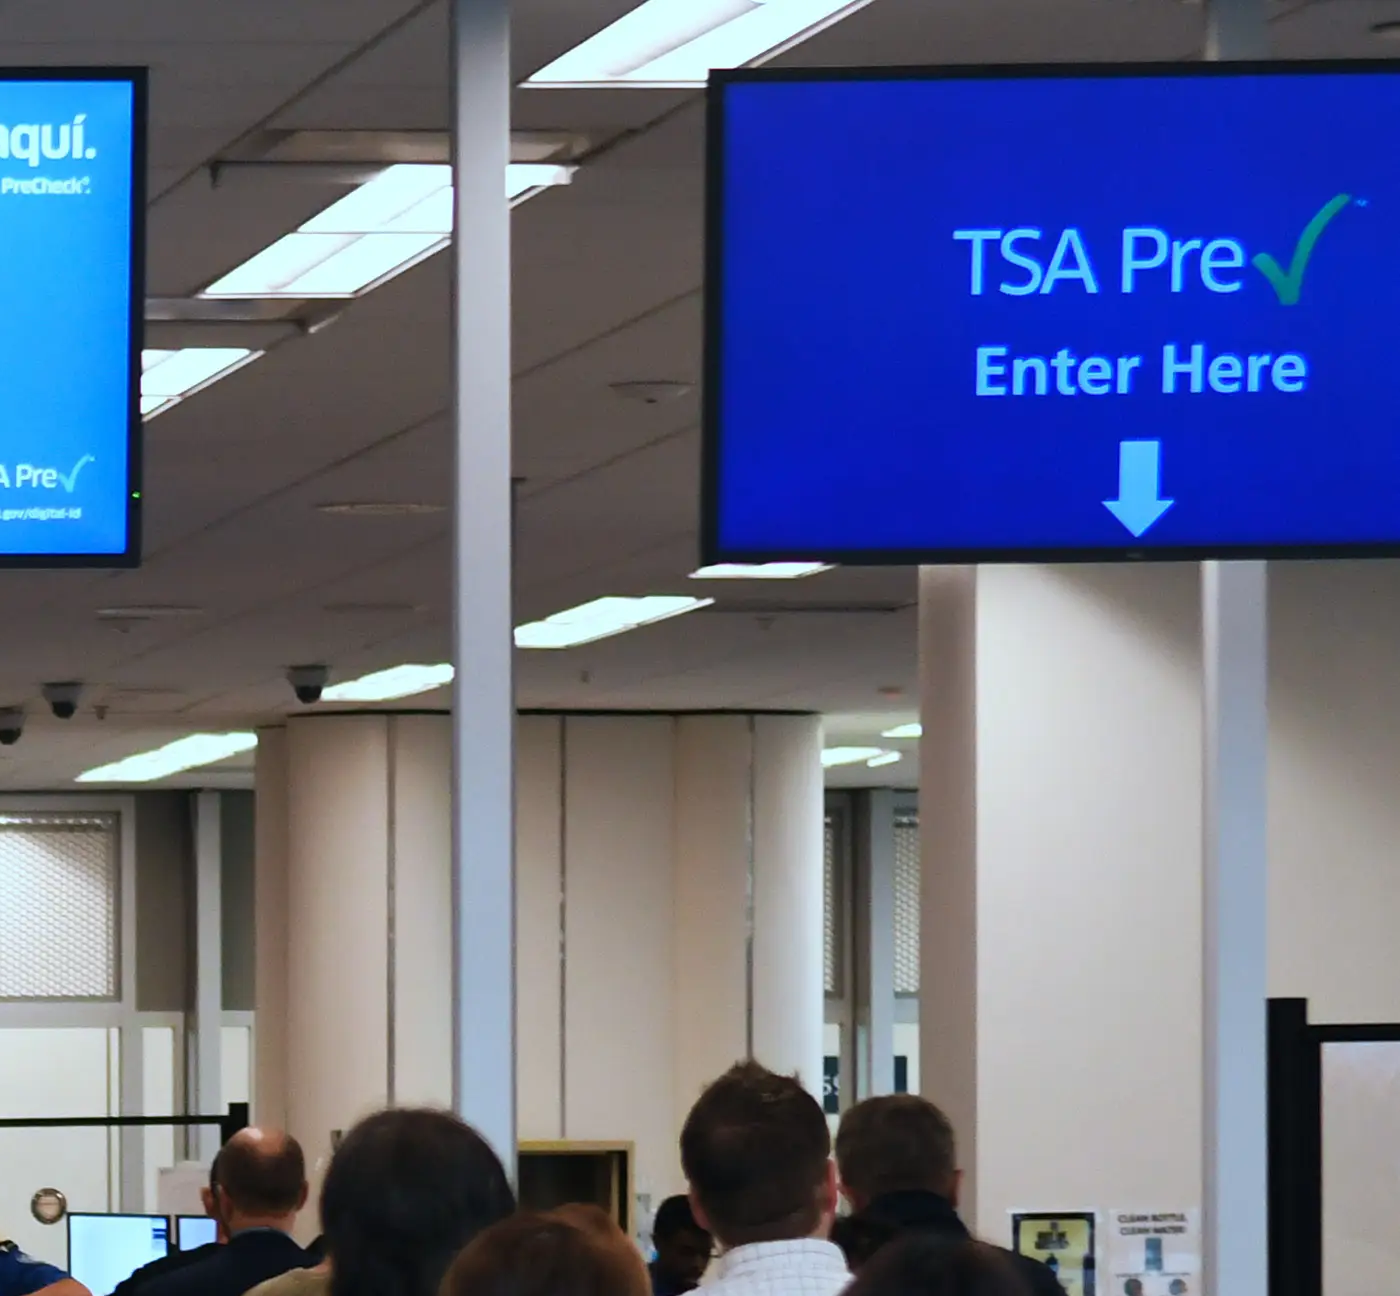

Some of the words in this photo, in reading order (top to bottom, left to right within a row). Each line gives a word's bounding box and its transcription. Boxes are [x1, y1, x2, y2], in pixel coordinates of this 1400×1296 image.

[953, 228, 1099, 296] TSA
[1121, 227, 1245, 294] Pre
[976, 346, 1141, 396] Enter
[1162, 344, 1307, 394] Here
[15, 464, 58, 489] Pre
